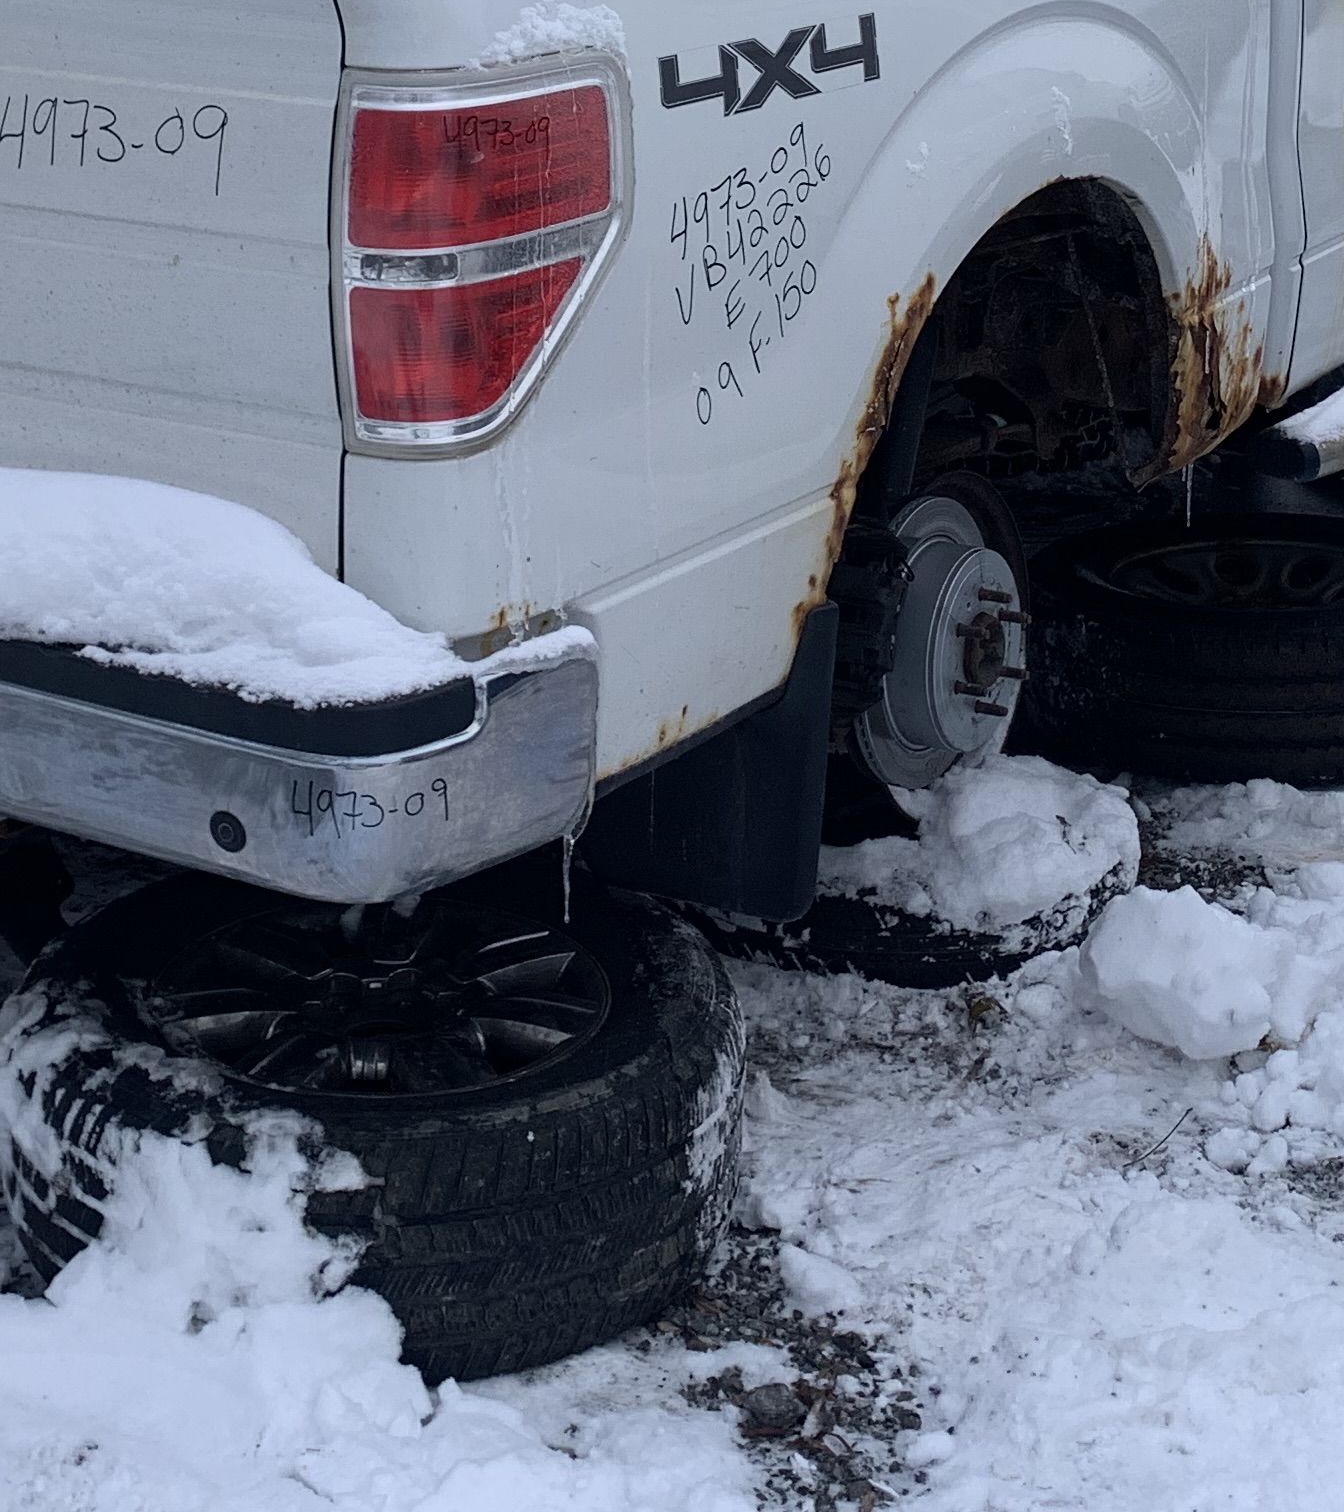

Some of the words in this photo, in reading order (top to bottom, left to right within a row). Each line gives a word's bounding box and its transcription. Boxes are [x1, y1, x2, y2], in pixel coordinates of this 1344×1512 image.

[657, 12, 880, 118] 4X4
[443, 115, 550, 161] 4973-09
[671, 122, 808, 260] 4973-09
[292, 778, 449, 839] 4973-09
